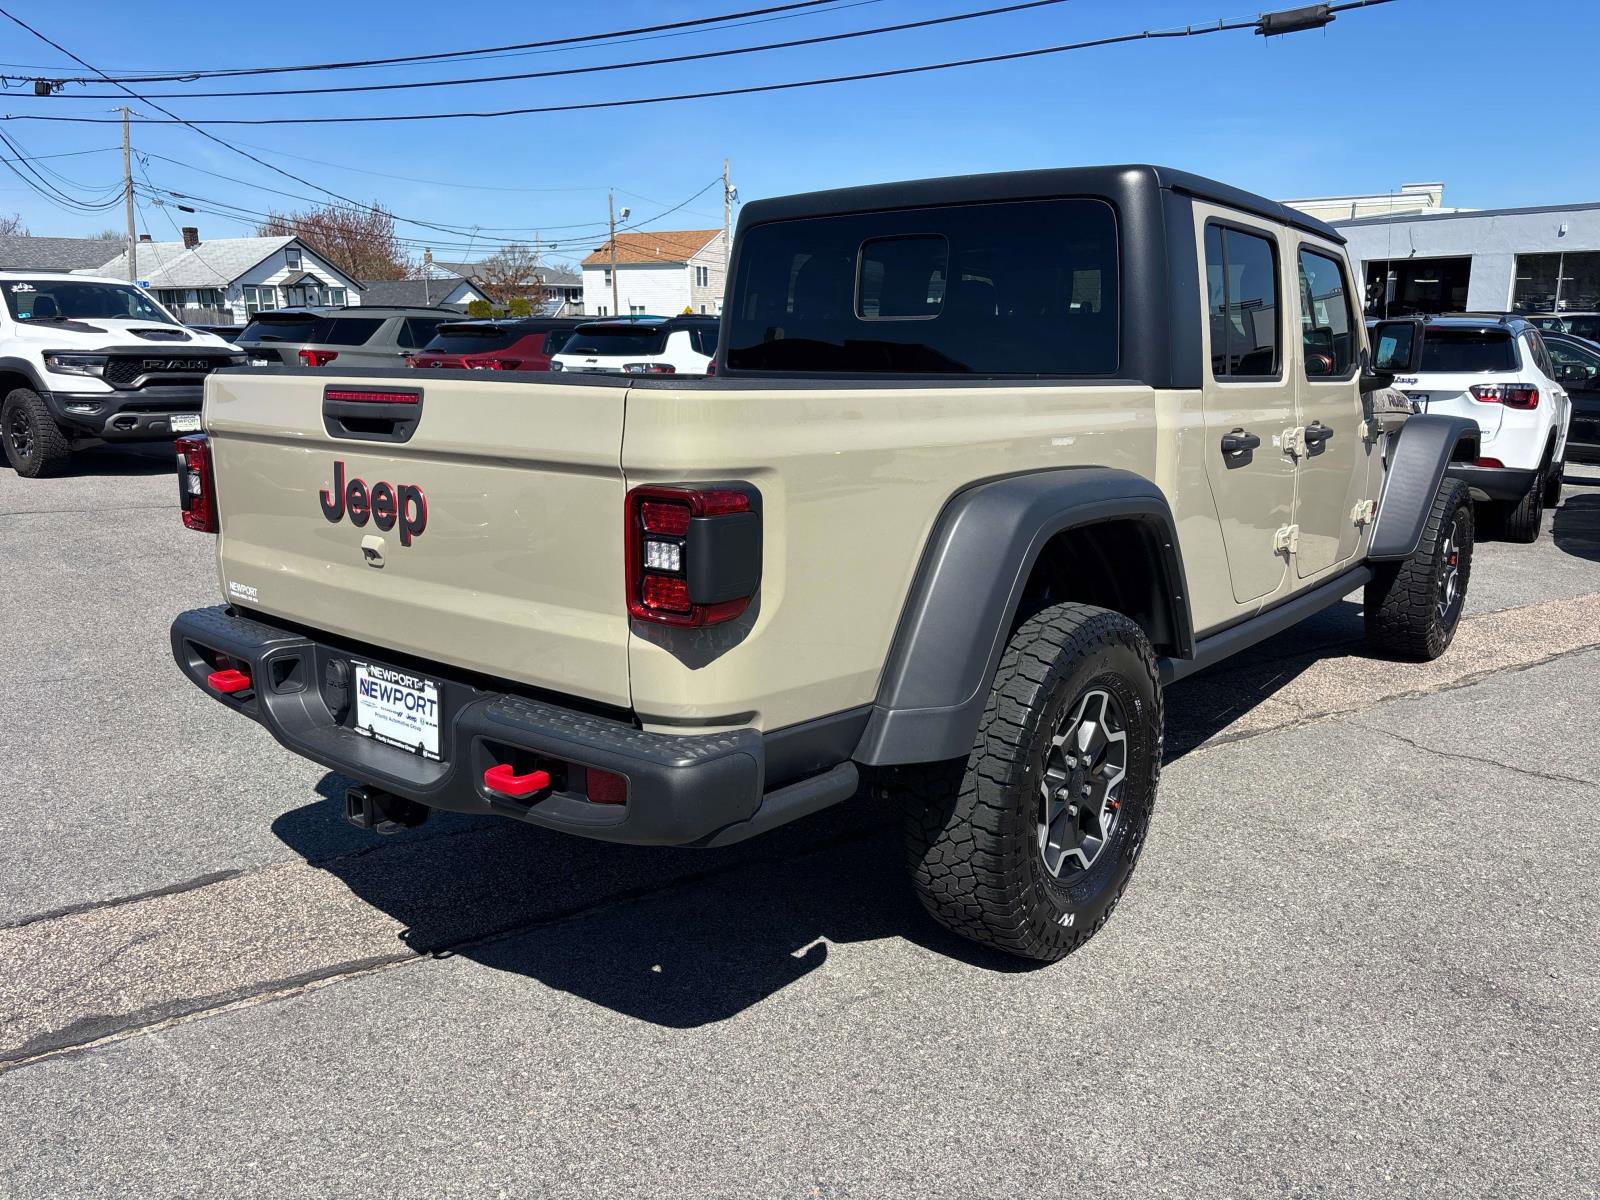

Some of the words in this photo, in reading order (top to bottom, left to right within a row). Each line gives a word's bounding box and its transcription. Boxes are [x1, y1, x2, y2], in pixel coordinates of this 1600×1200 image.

[143, 360, 208, 369] RAM
[319, 461, 428, 547] Jeep
[370, 665, 418, 689] NEWPORT
[359, 678, 437, 718] NEWPORT
